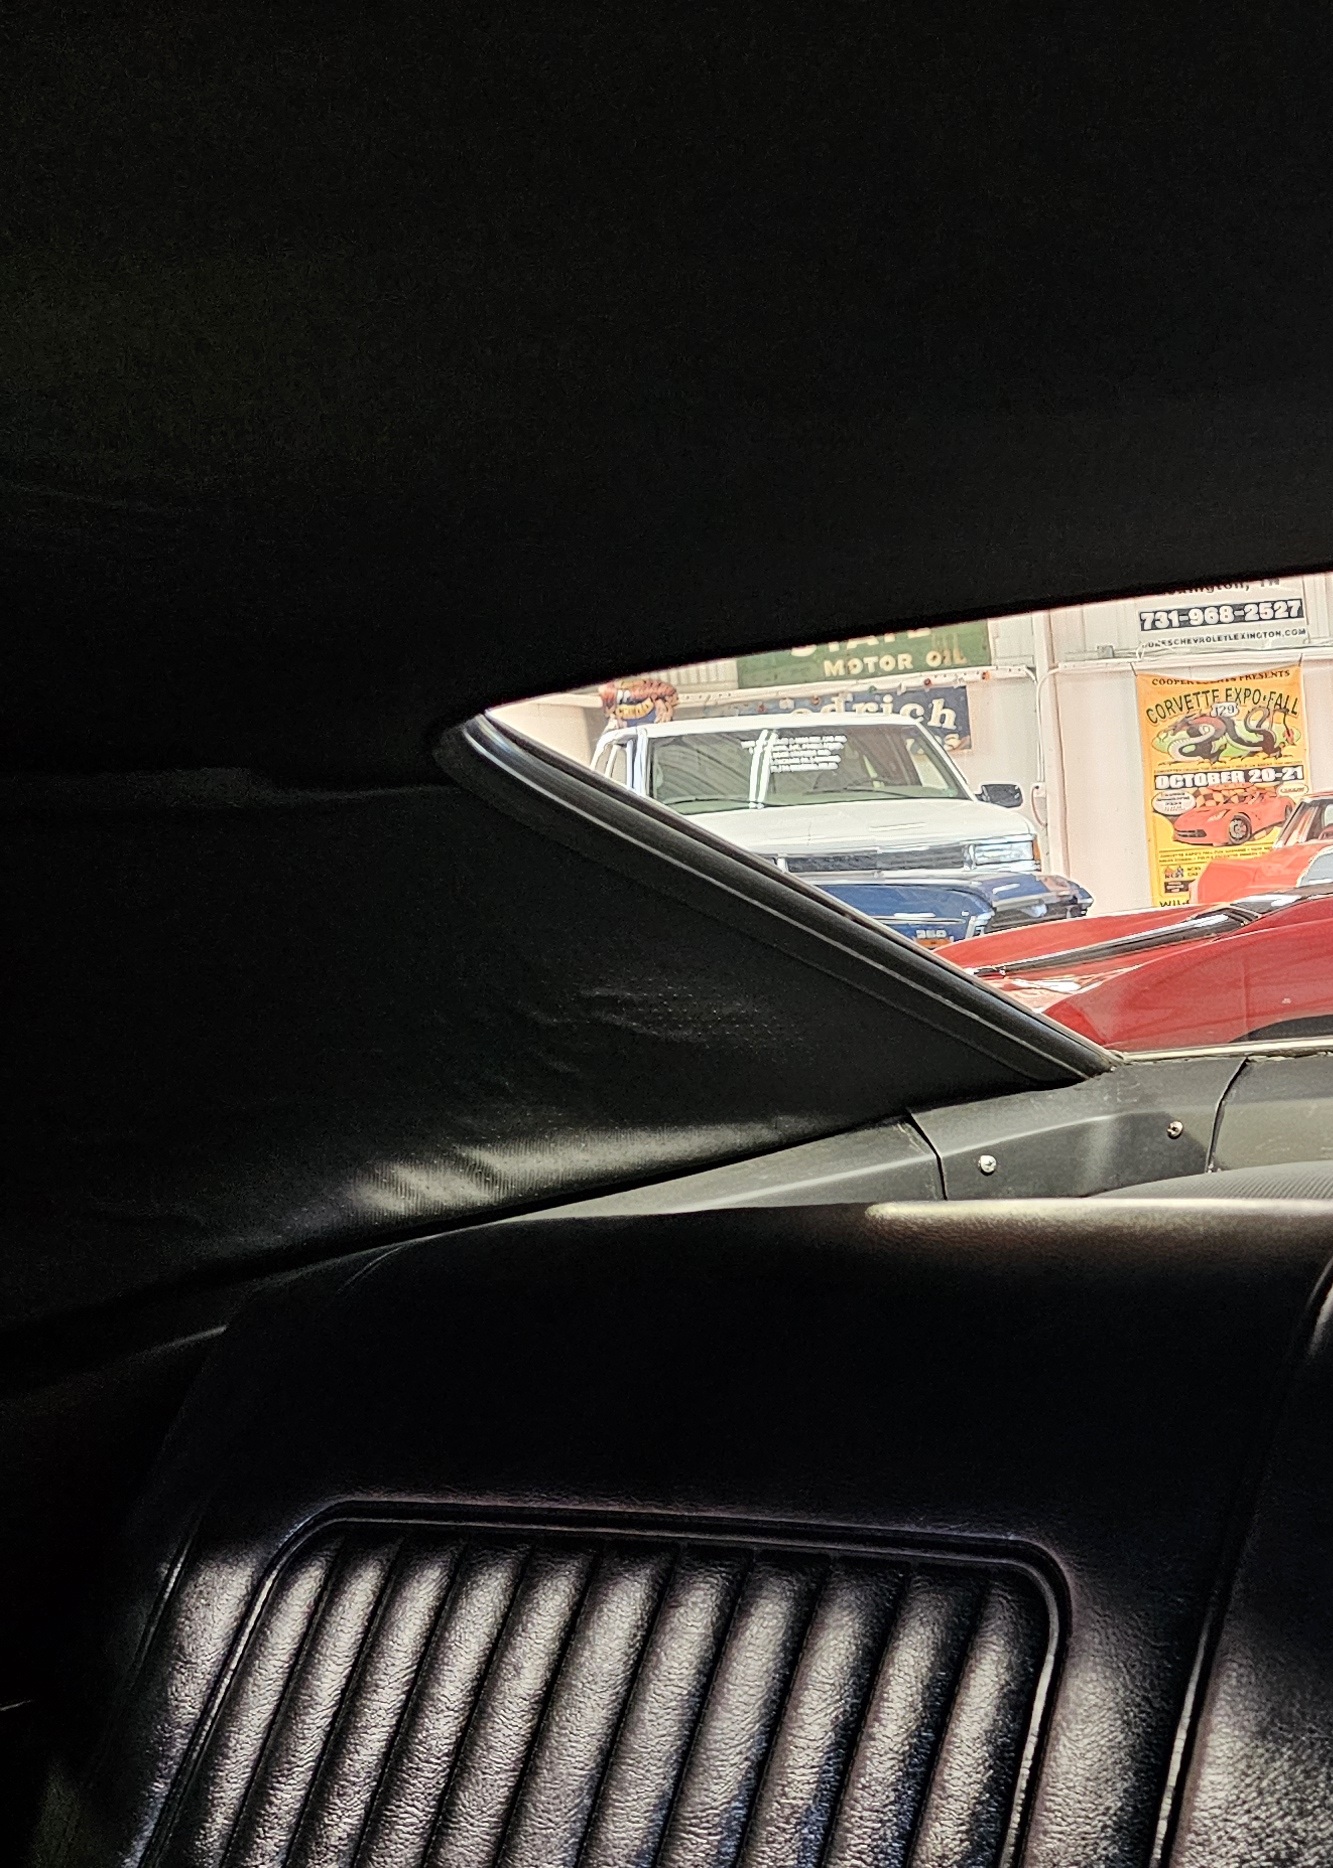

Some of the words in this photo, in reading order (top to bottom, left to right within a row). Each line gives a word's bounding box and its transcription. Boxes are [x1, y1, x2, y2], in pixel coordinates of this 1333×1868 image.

[1140, 600, 1302, 631] 731-968-2527
[823, 653, 913, 677] MOTOR
[926, 650, 967, 668] OIL
[1146, 688, 1219, 724] CORVETTE
[1155, 770, 1246, 790] OCTOBER
[1248, 765, 1303, 783] 20-21
